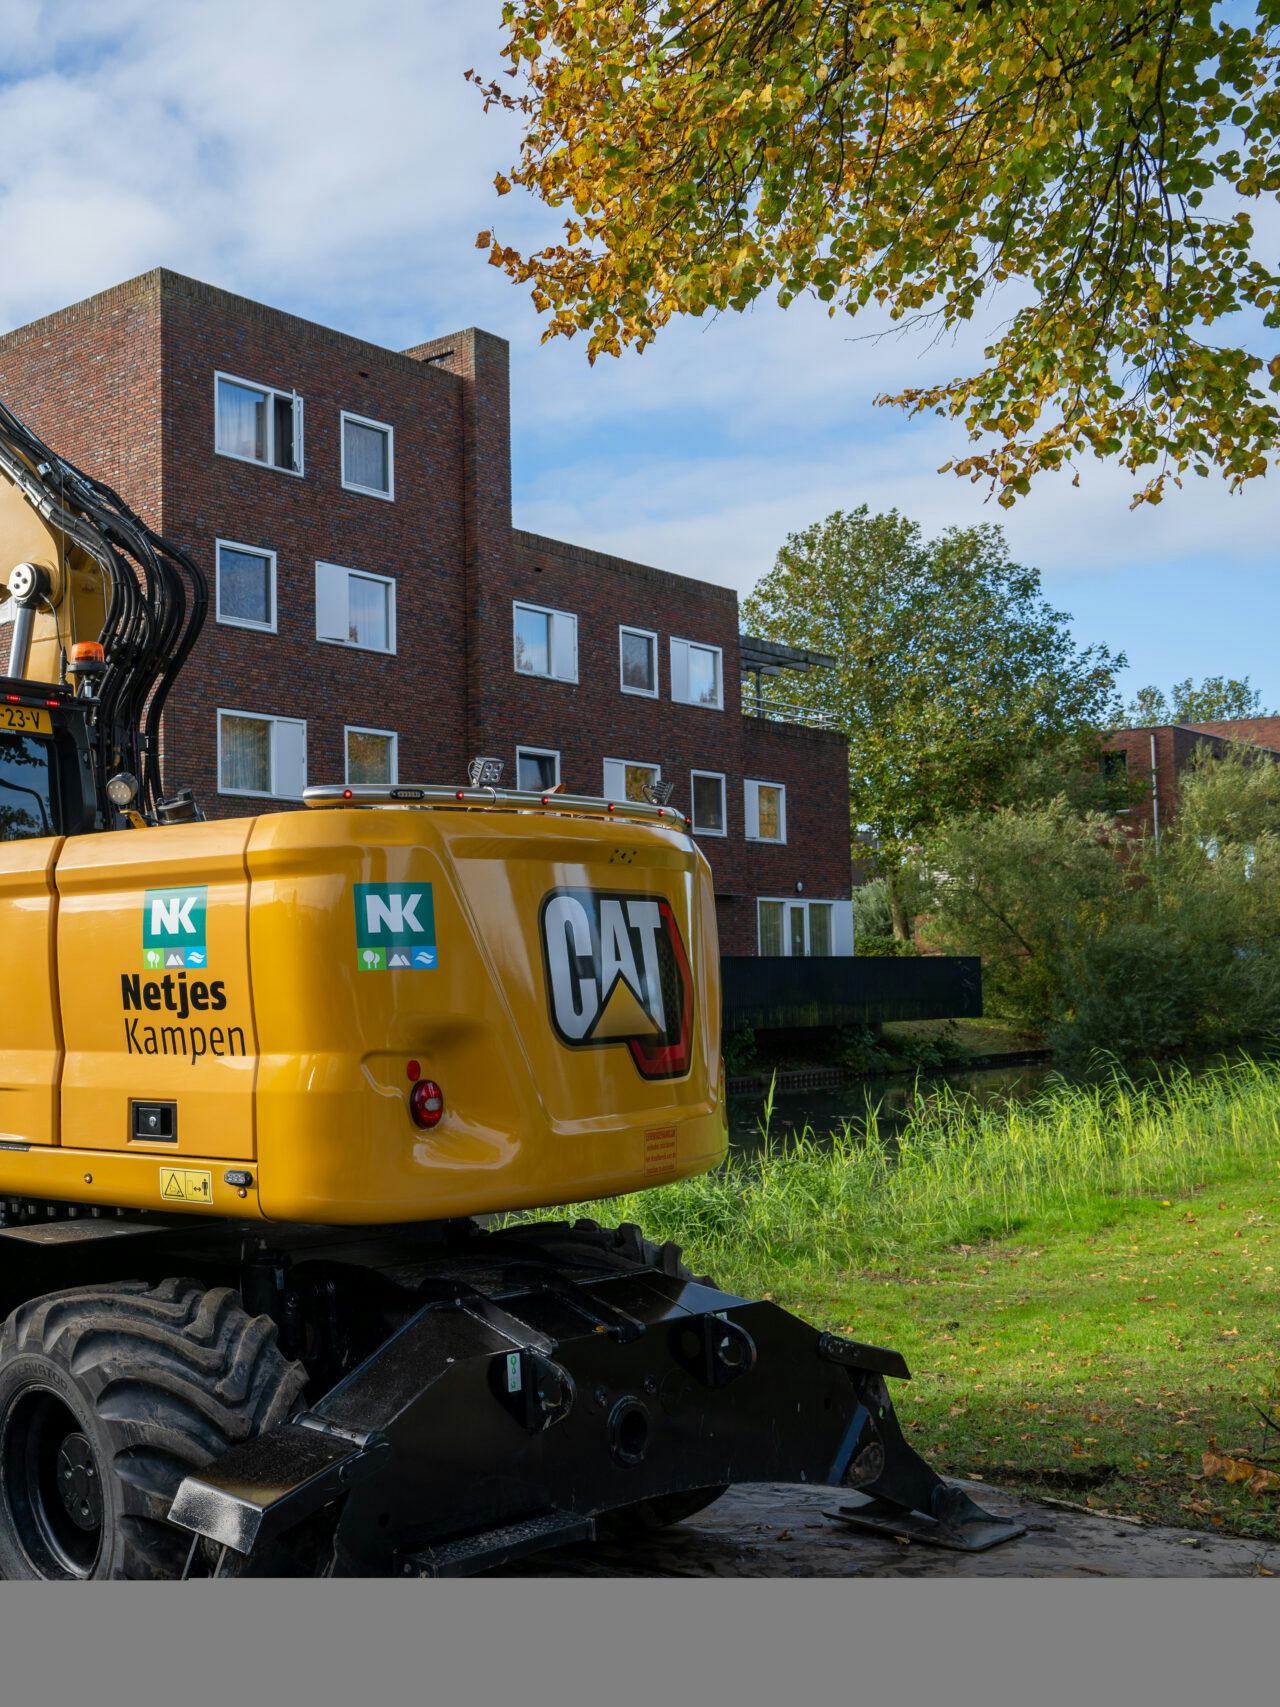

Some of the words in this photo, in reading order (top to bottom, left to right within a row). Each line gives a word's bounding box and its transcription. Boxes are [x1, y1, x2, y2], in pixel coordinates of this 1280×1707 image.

[151, 896, 198, 935] NK
[365, 893, 425, 934] NK
[544, 896, 667, 1040] CAT
[121, 971, 227, 1019] Netjes
[124, 1018, 246, 1065] Kampen
